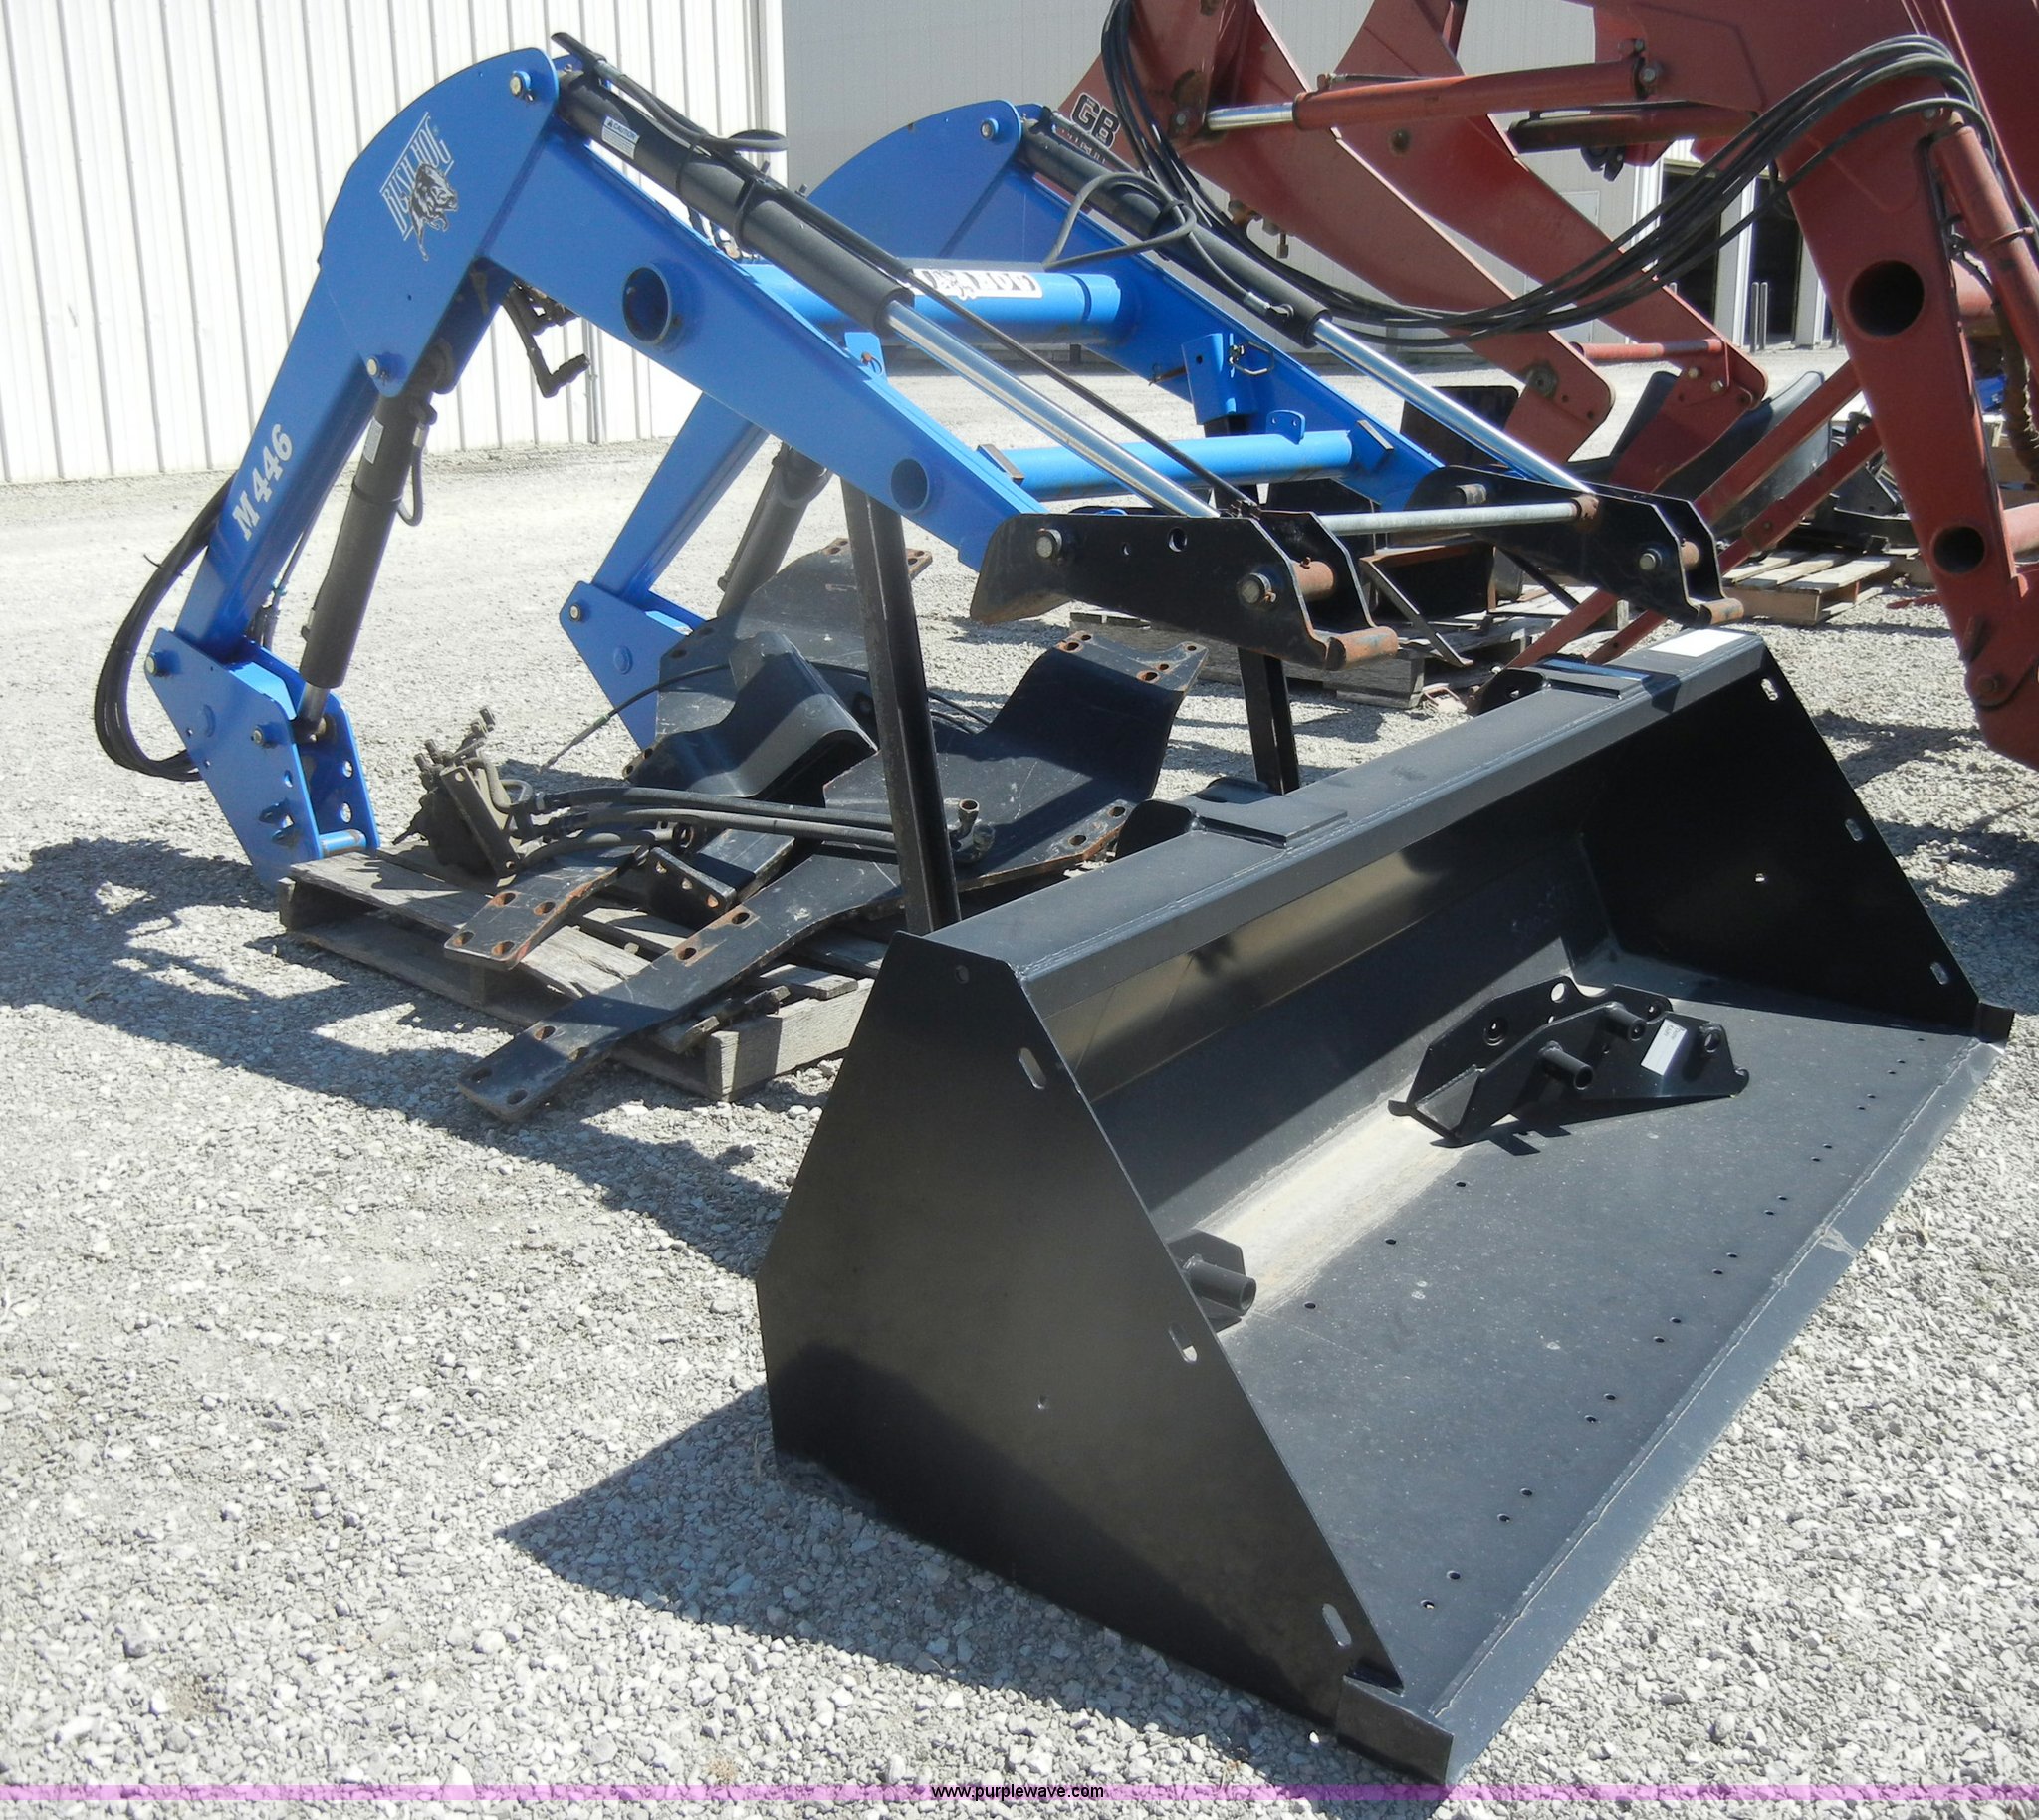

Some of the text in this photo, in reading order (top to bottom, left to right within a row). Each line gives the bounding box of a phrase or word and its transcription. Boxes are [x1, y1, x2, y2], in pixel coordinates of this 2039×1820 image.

[382, 115, 452, 236] BUSH HOG
[1070, 92, 1121, 149] GB
[232, 423, 293, 541] M 446
